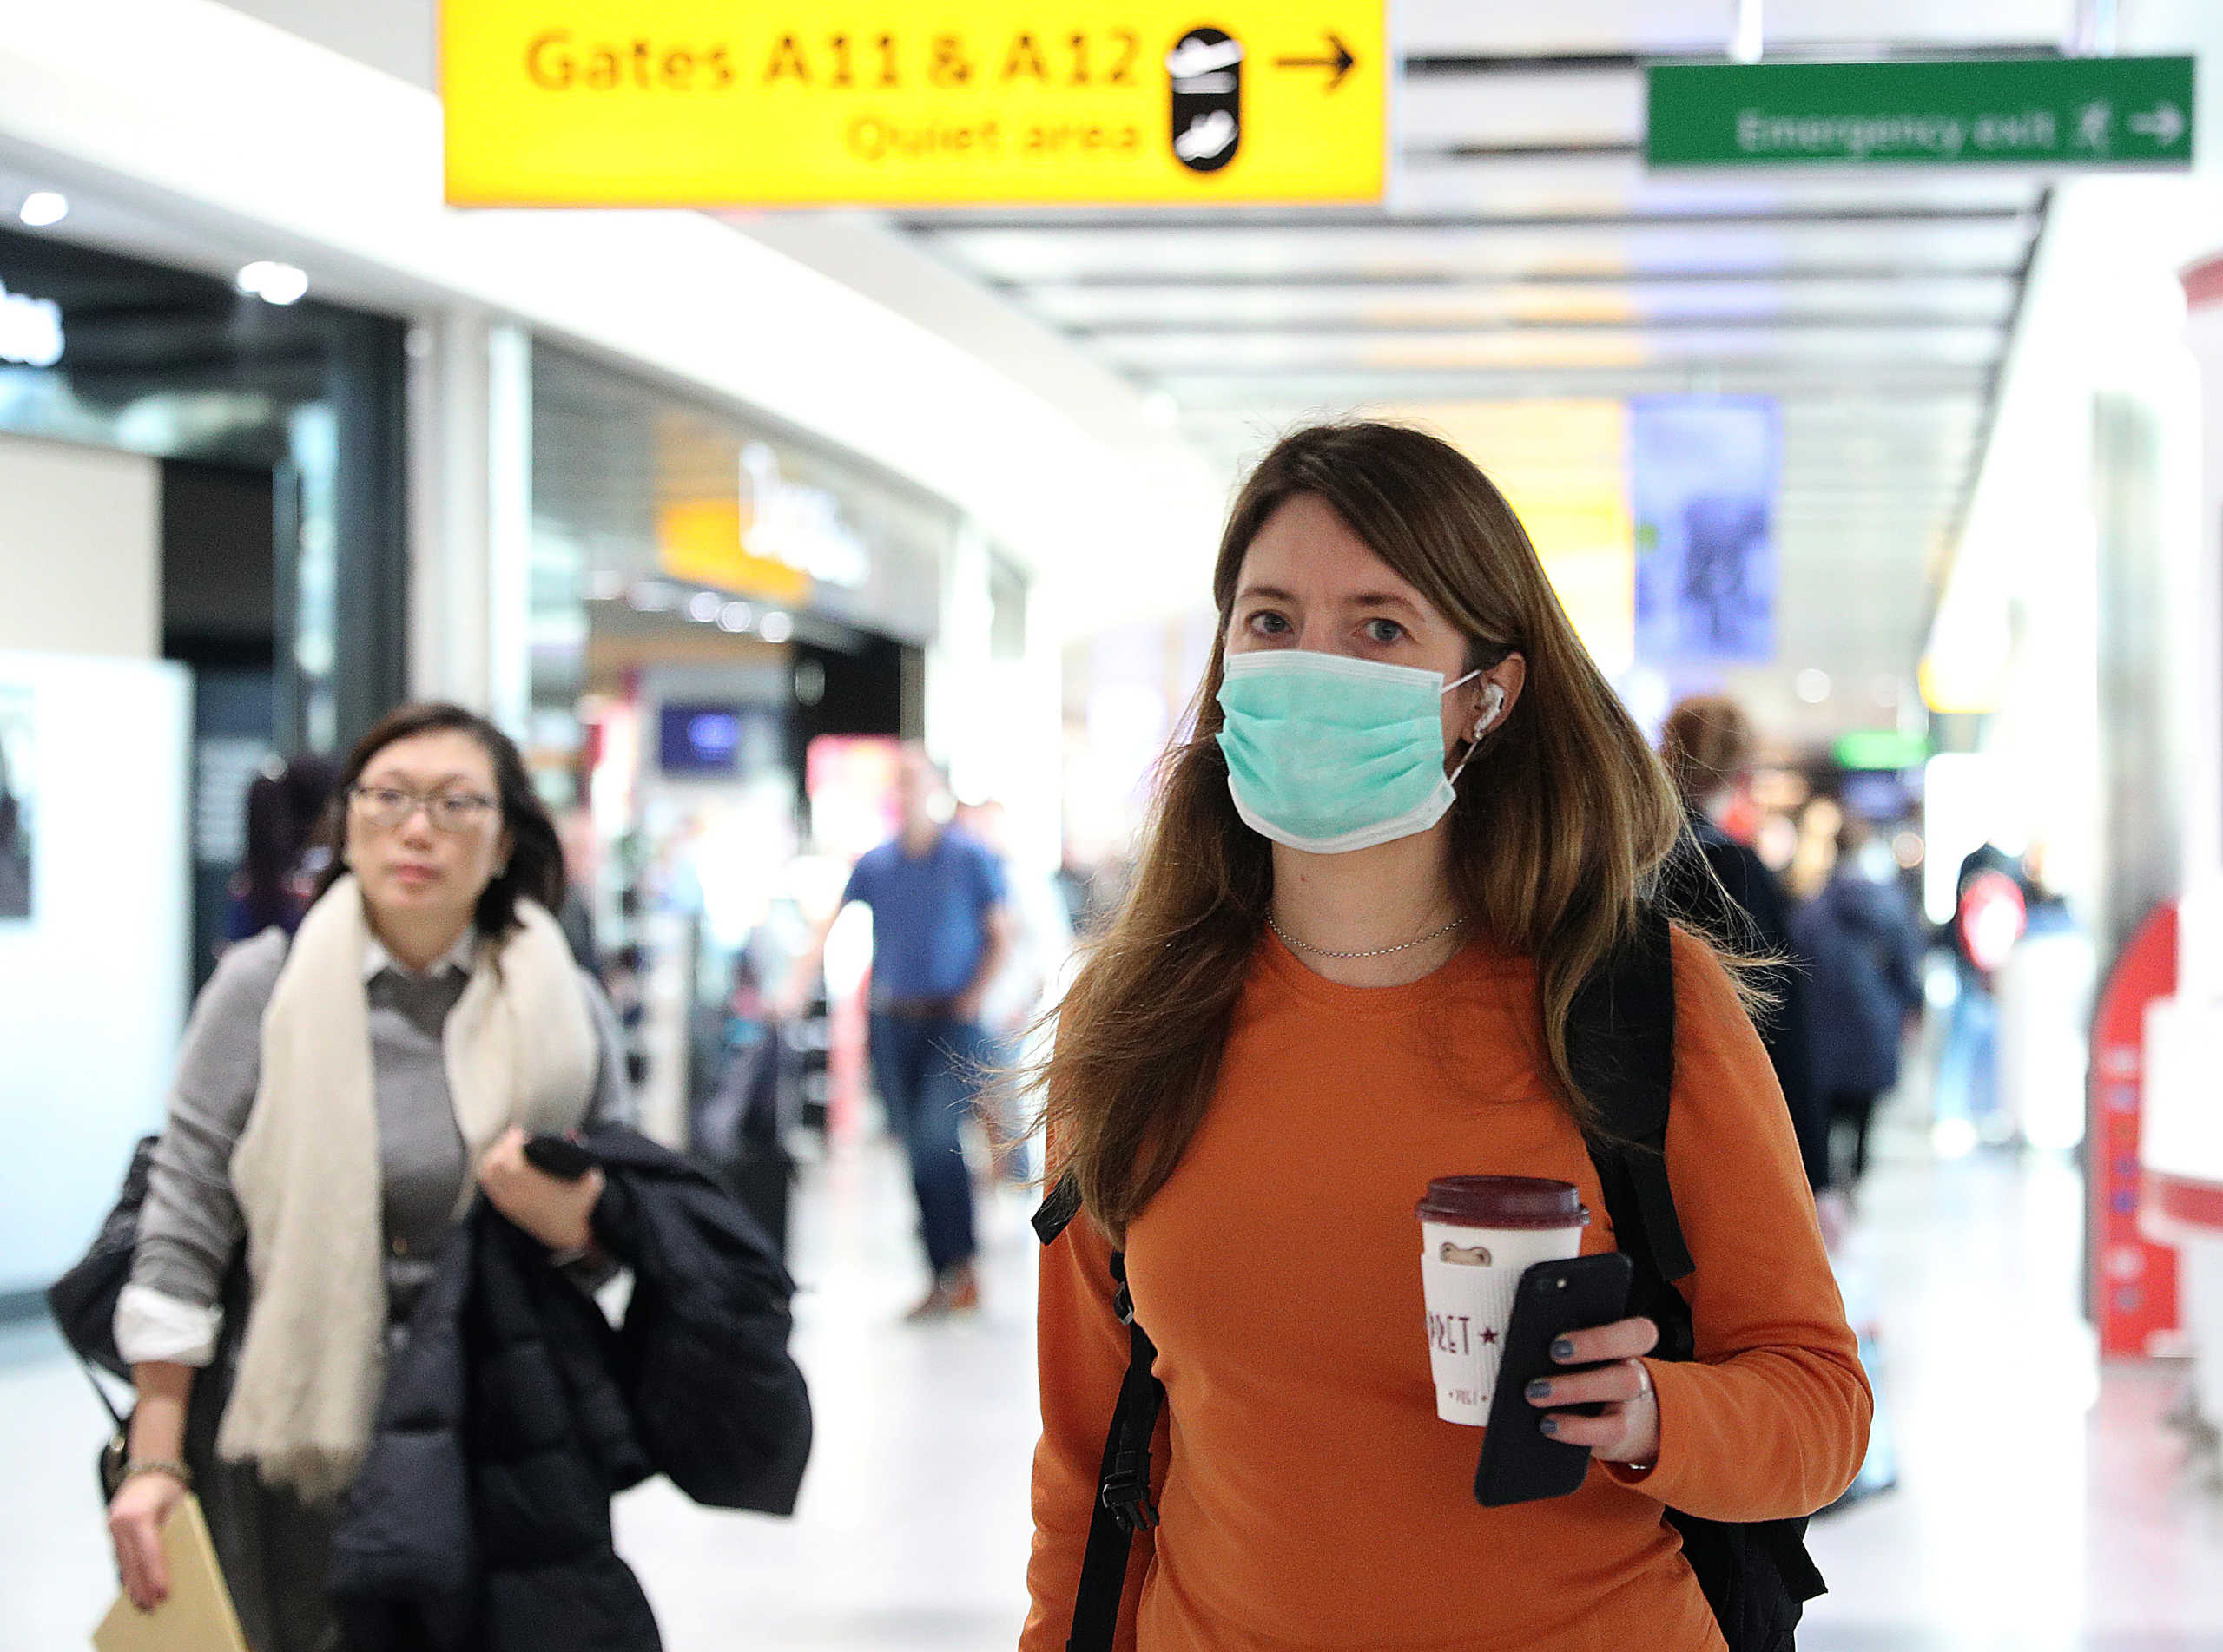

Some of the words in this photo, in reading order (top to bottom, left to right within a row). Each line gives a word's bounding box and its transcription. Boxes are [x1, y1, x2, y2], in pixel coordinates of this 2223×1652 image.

[525, 31, 734, 92] Gates
[762, 31, 900, 90] A11
[927, 32, 974, 90] &
[997, 30, 1139, 90] A12
[848, 115, 998, 160] Quiet
[1023, 123, 1139, 155] area
[1737, 109, 1964, 160] Emergency
[1973, 110, 2055, 150] exit
